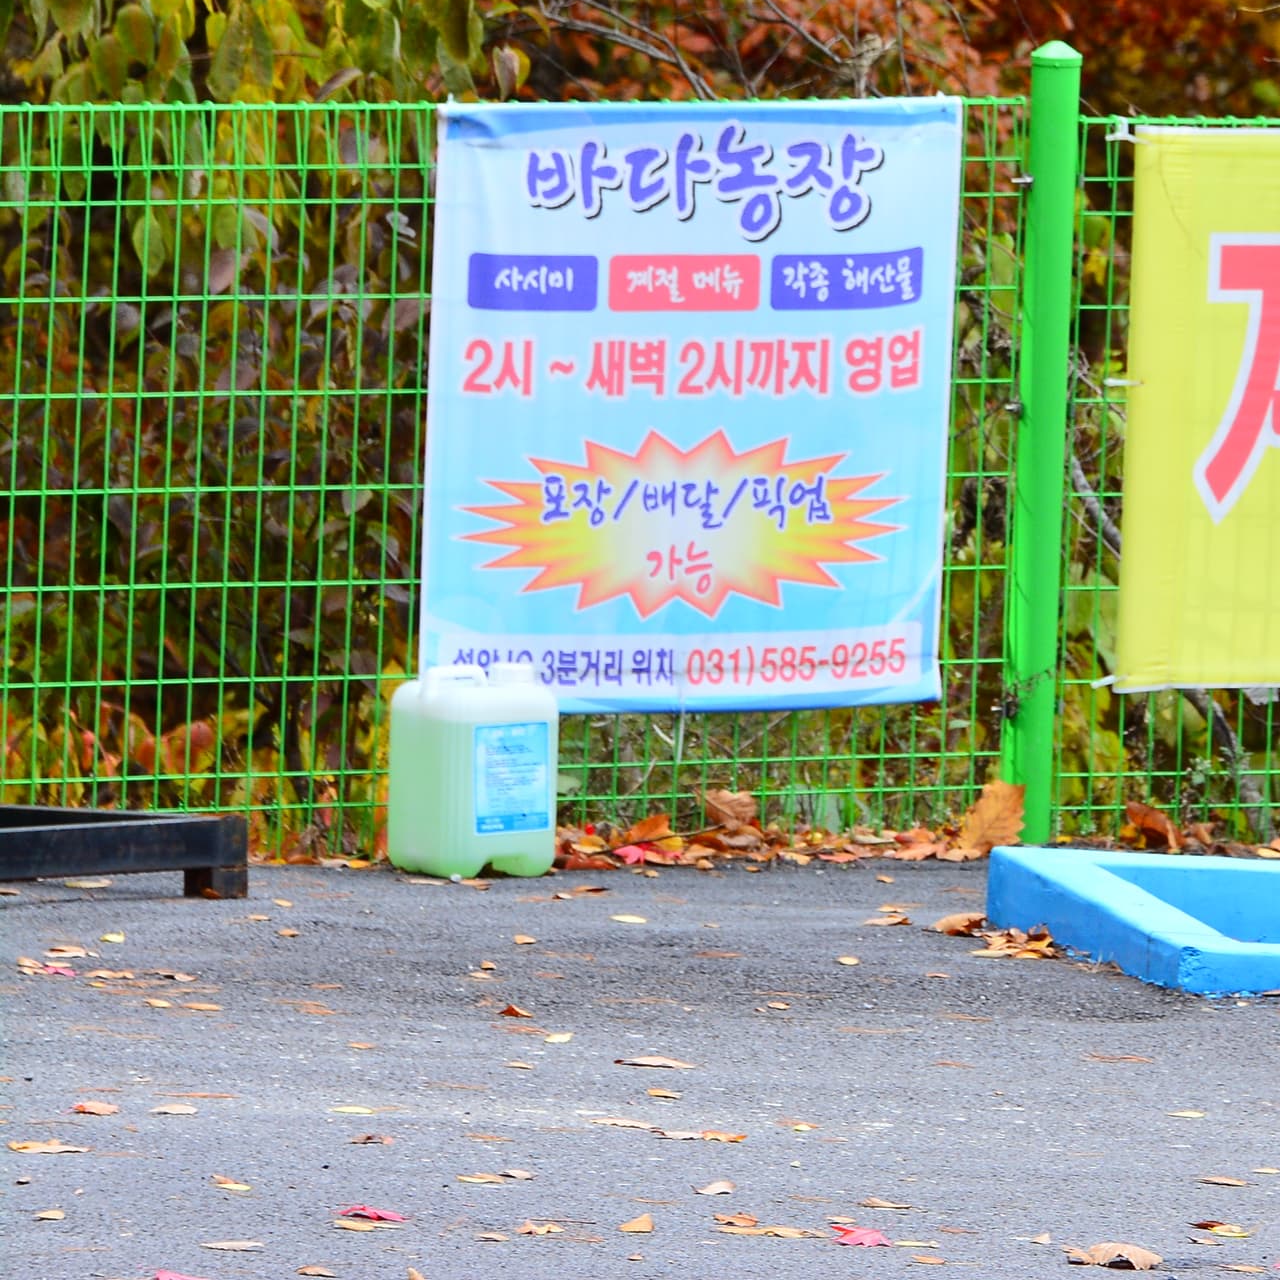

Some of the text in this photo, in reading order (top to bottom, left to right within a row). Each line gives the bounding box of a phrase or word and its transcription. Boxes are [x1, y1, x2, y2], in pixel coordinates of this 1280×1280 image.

[525, 122, 881, 238] 바다농장
[493, 267, 575, 294] 사시미
[626, 265, 745, 304] 계절 메뉴
[781, 254, 916, 303] 각종 해산물
[462, 338, 533, 396] 2시
[585, 339, 666, 397] 새벽
[676, 338, 830, 396] 2시까지
[844, 329, 921, 394] 영업
[646, 540, 713, 595] 가능
[540, 648, 624, 687] 3분거리
[630, 648, 674, 687] 위치
[686, 637, 907, 687] 031)585-9255
